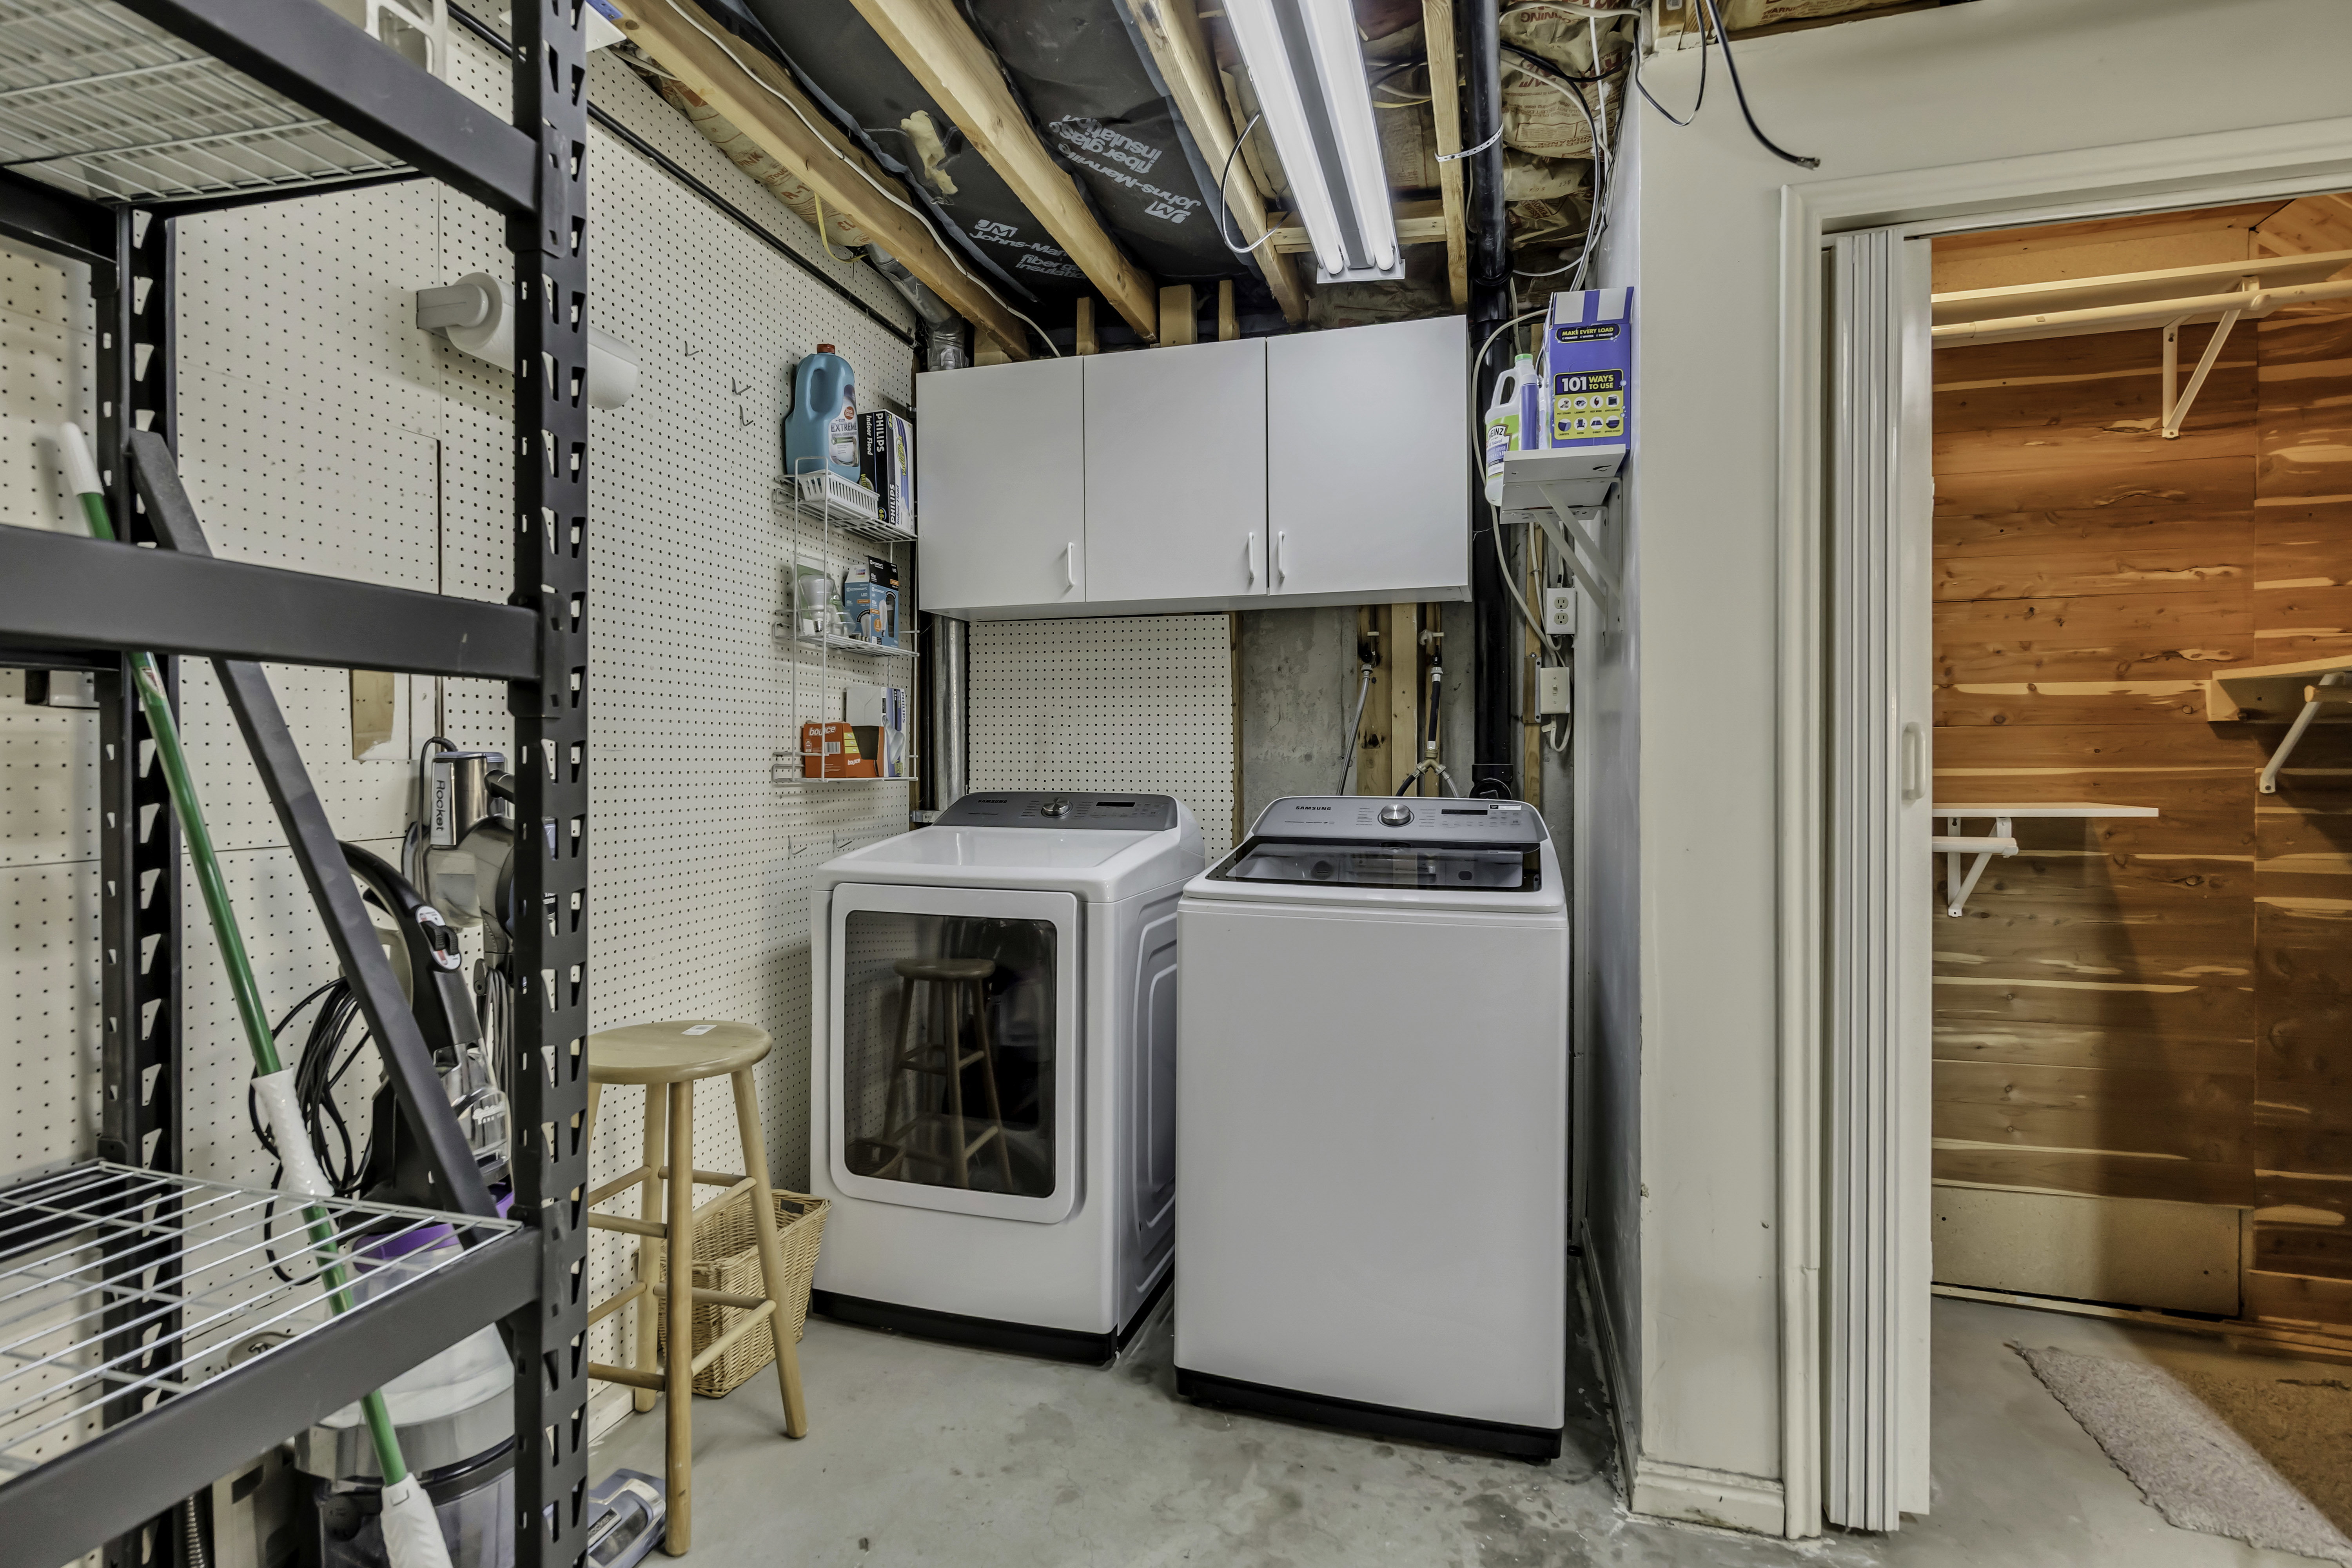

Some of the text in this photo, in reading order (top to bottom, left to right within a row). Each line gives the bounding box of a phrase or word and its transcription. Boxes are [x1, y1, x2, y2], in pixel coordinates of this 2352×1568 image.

[1062, 114, 1162, 165] insulation
[738, 152, 763, 168] PINK
[1058, 143, 1201, 209] Johns-Manville
[781, 183, 811, 200] R-1
[837, 220, 857, 232] 13
[974, 219, 1018, 237] JM
[969, 231, 1067, 258] Johns-Man
[1015, 260, 1087, 280] insulatio
[1562, 376, 1586, 392] 101
[1589, 375, 1614, 383] WAYS
[831, 423, 857, 432] EXTREME
[876, 413, 885, 452] PHILIPS
[1489, 428, 1504, 440] HEINZ
